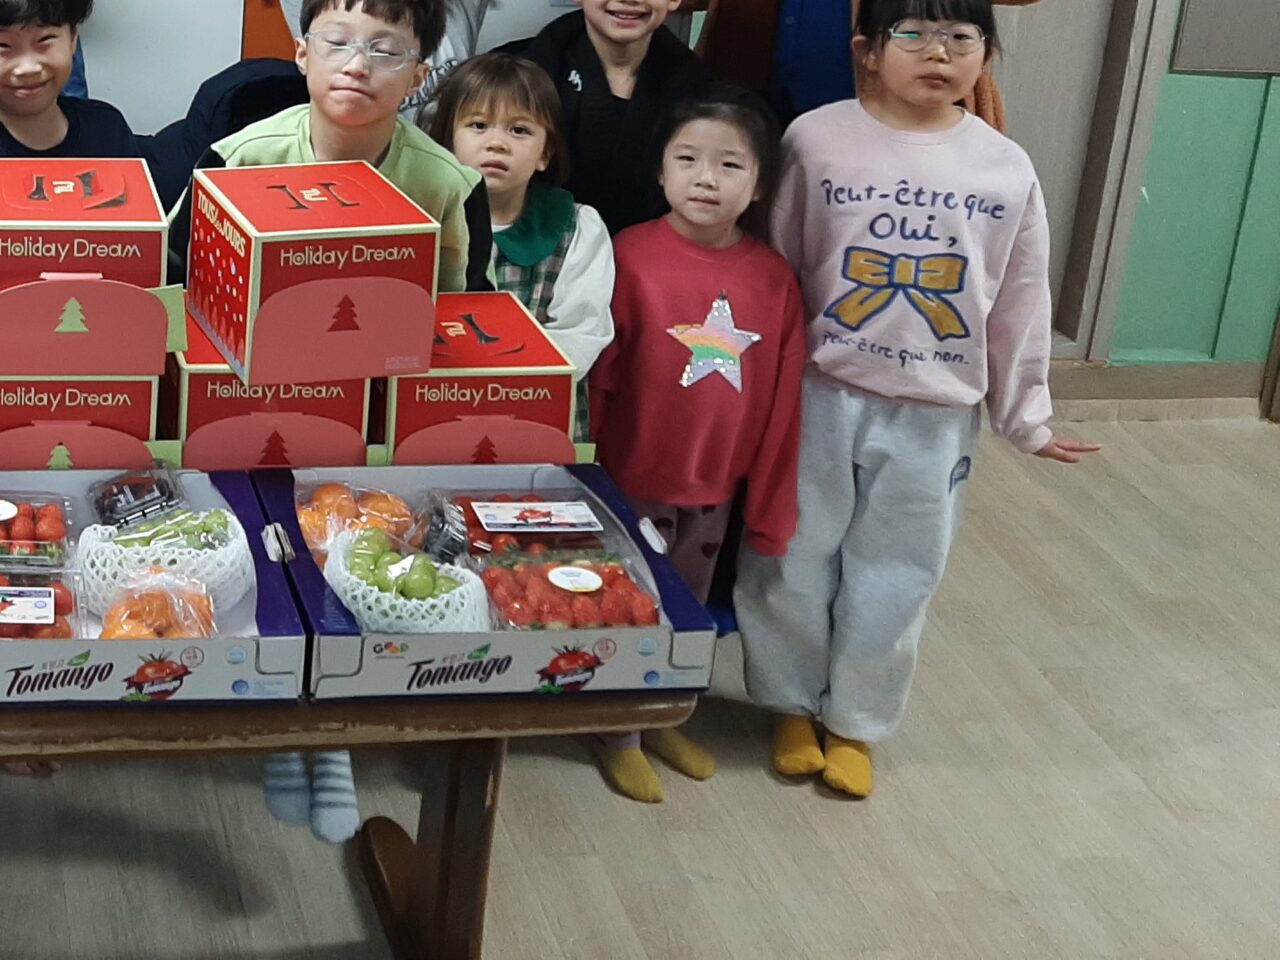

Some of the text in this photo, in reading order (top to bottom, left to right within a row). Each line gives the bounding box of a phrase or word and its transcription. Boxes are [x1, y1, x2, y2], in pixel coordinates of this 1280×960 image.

[964, 194, 1006, 220] que
[73, 240, 142, 259] Dream
[279, 244, 416, 269] Holiday Dream
[66, 387, 132, 408] Dream
[207, 379, 276, 403] Holiday
[415, 383, 552, 408] Holiday Dream
[5, 662, 114, 697] Tomango
[406, 654, 513, 691] Tomango
